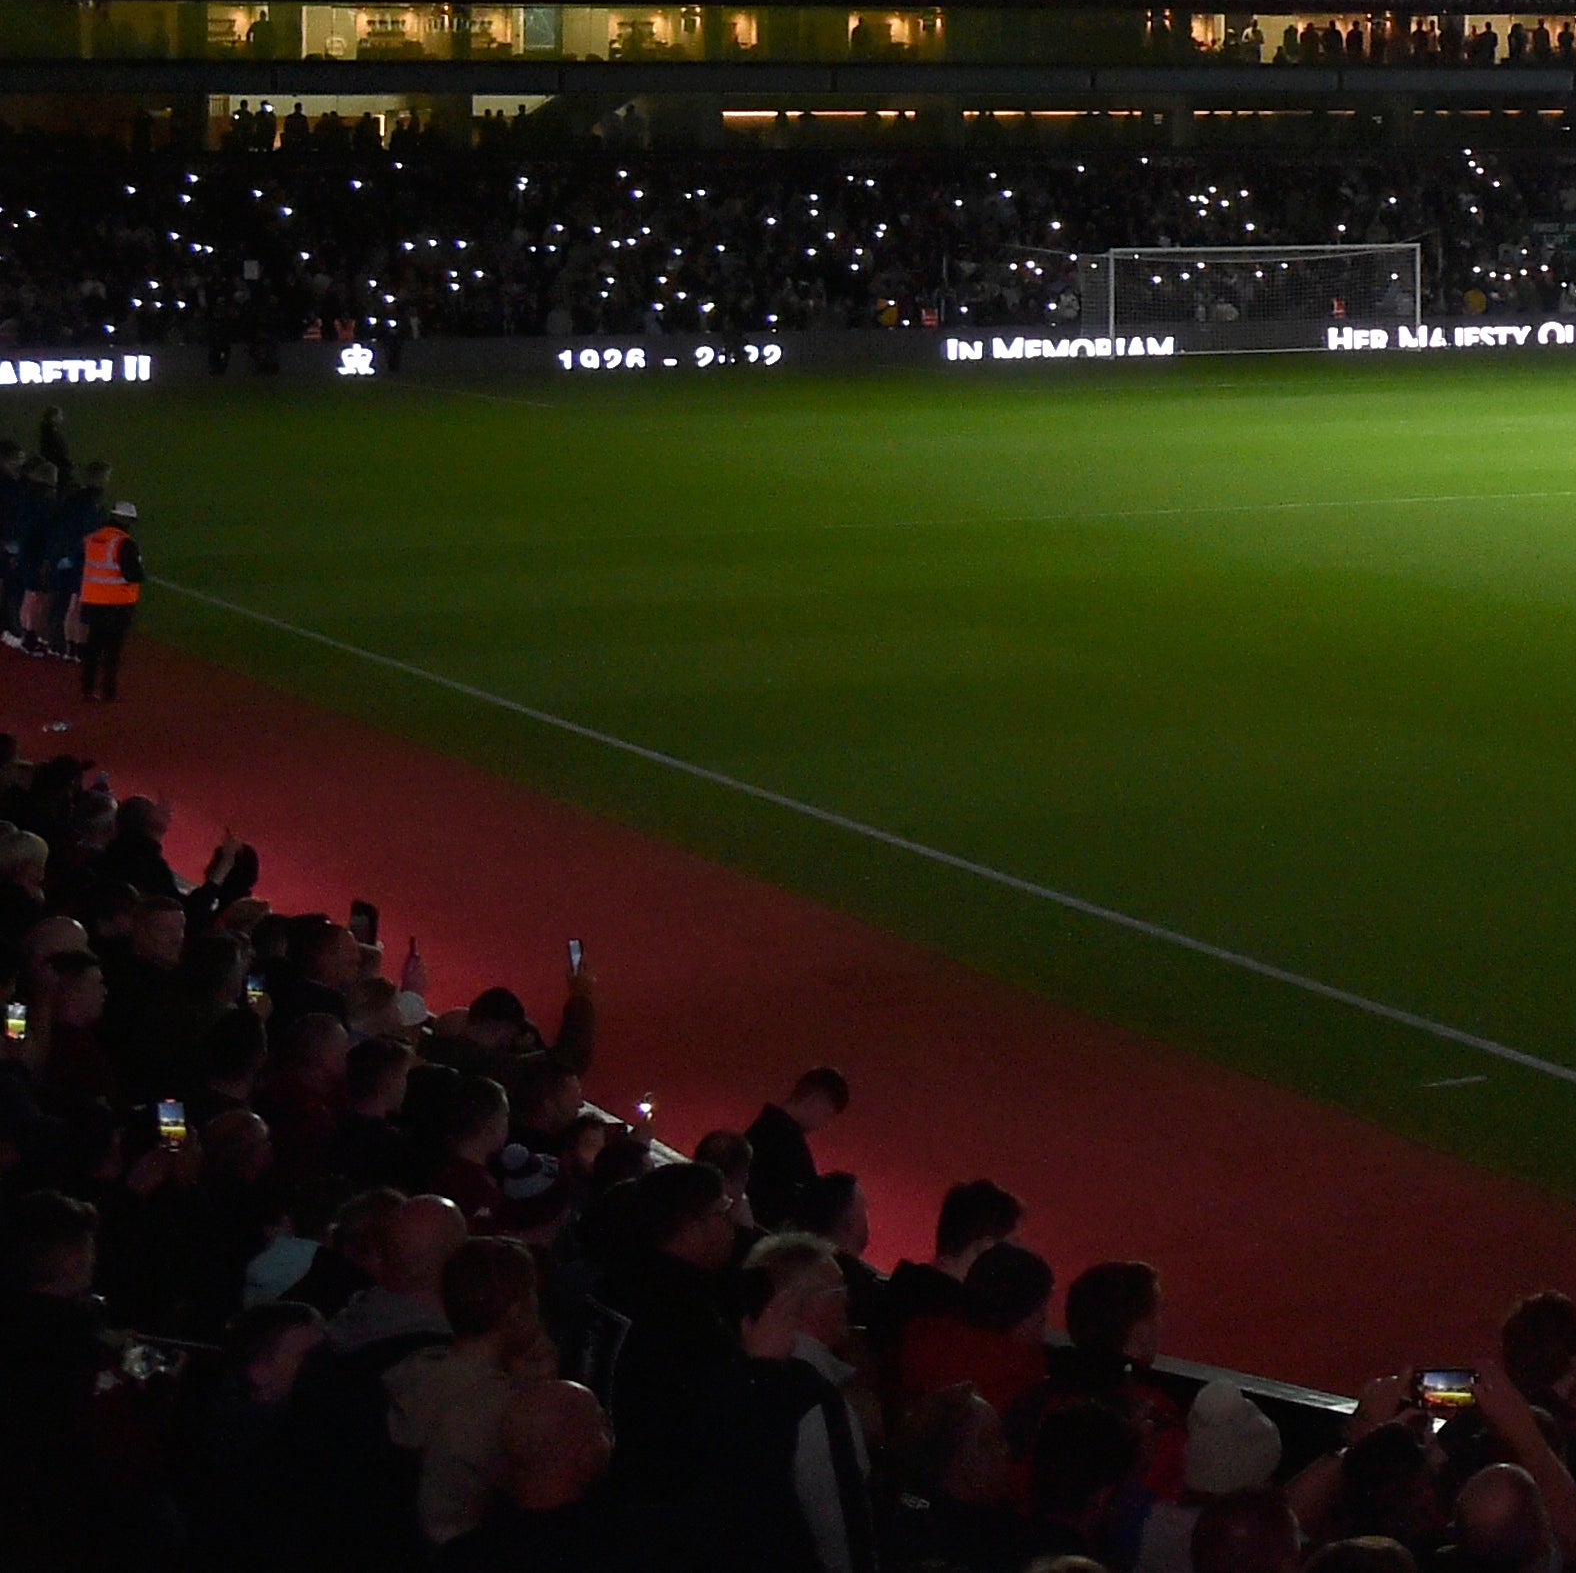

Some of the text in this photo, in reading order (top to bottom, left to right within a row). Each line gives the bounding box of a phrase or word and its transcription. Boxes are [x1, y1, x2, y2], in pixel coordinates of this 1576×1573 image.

[946, 335, 1175, 361] IN MEMORIAM
[1327, 326, 1390, 350] HER
[1397, 322, 1531, 348] MAJESTY
[124, 355, 151, 381] II
[558, 348, 645, 369] 1926
[695, 344, 781, 367] 222
